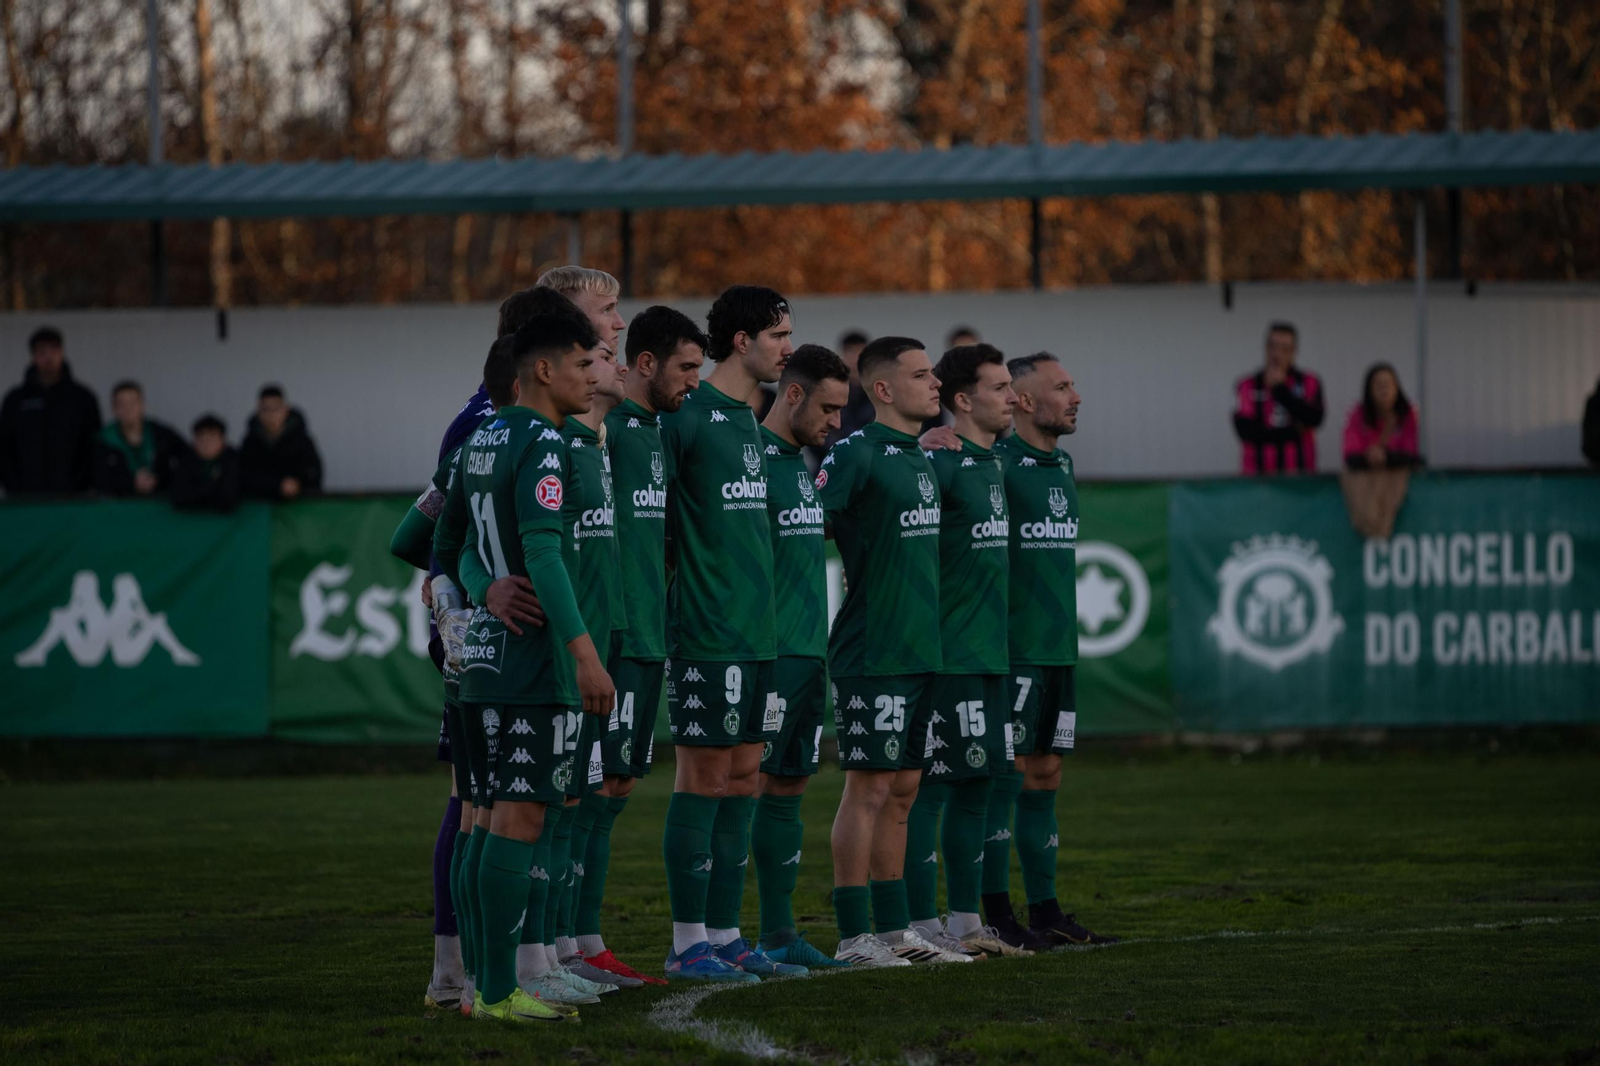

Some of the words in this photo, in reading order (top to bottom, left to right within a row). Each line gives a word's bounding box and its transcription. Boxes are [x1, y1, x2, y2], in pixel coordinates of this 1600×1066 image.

[470, 491, 511, 579] 11
[1363, 531, 1575, 588] CONCELLO
[1364, 611, 1421, 667] DO
[725, 665, 742, 704] 9
[1013, 676, 1032, 711] 7
[620, 691, 634, 730] 4
[874, 694, 906, 732] 25
[955, 700, 986, 737] 15
